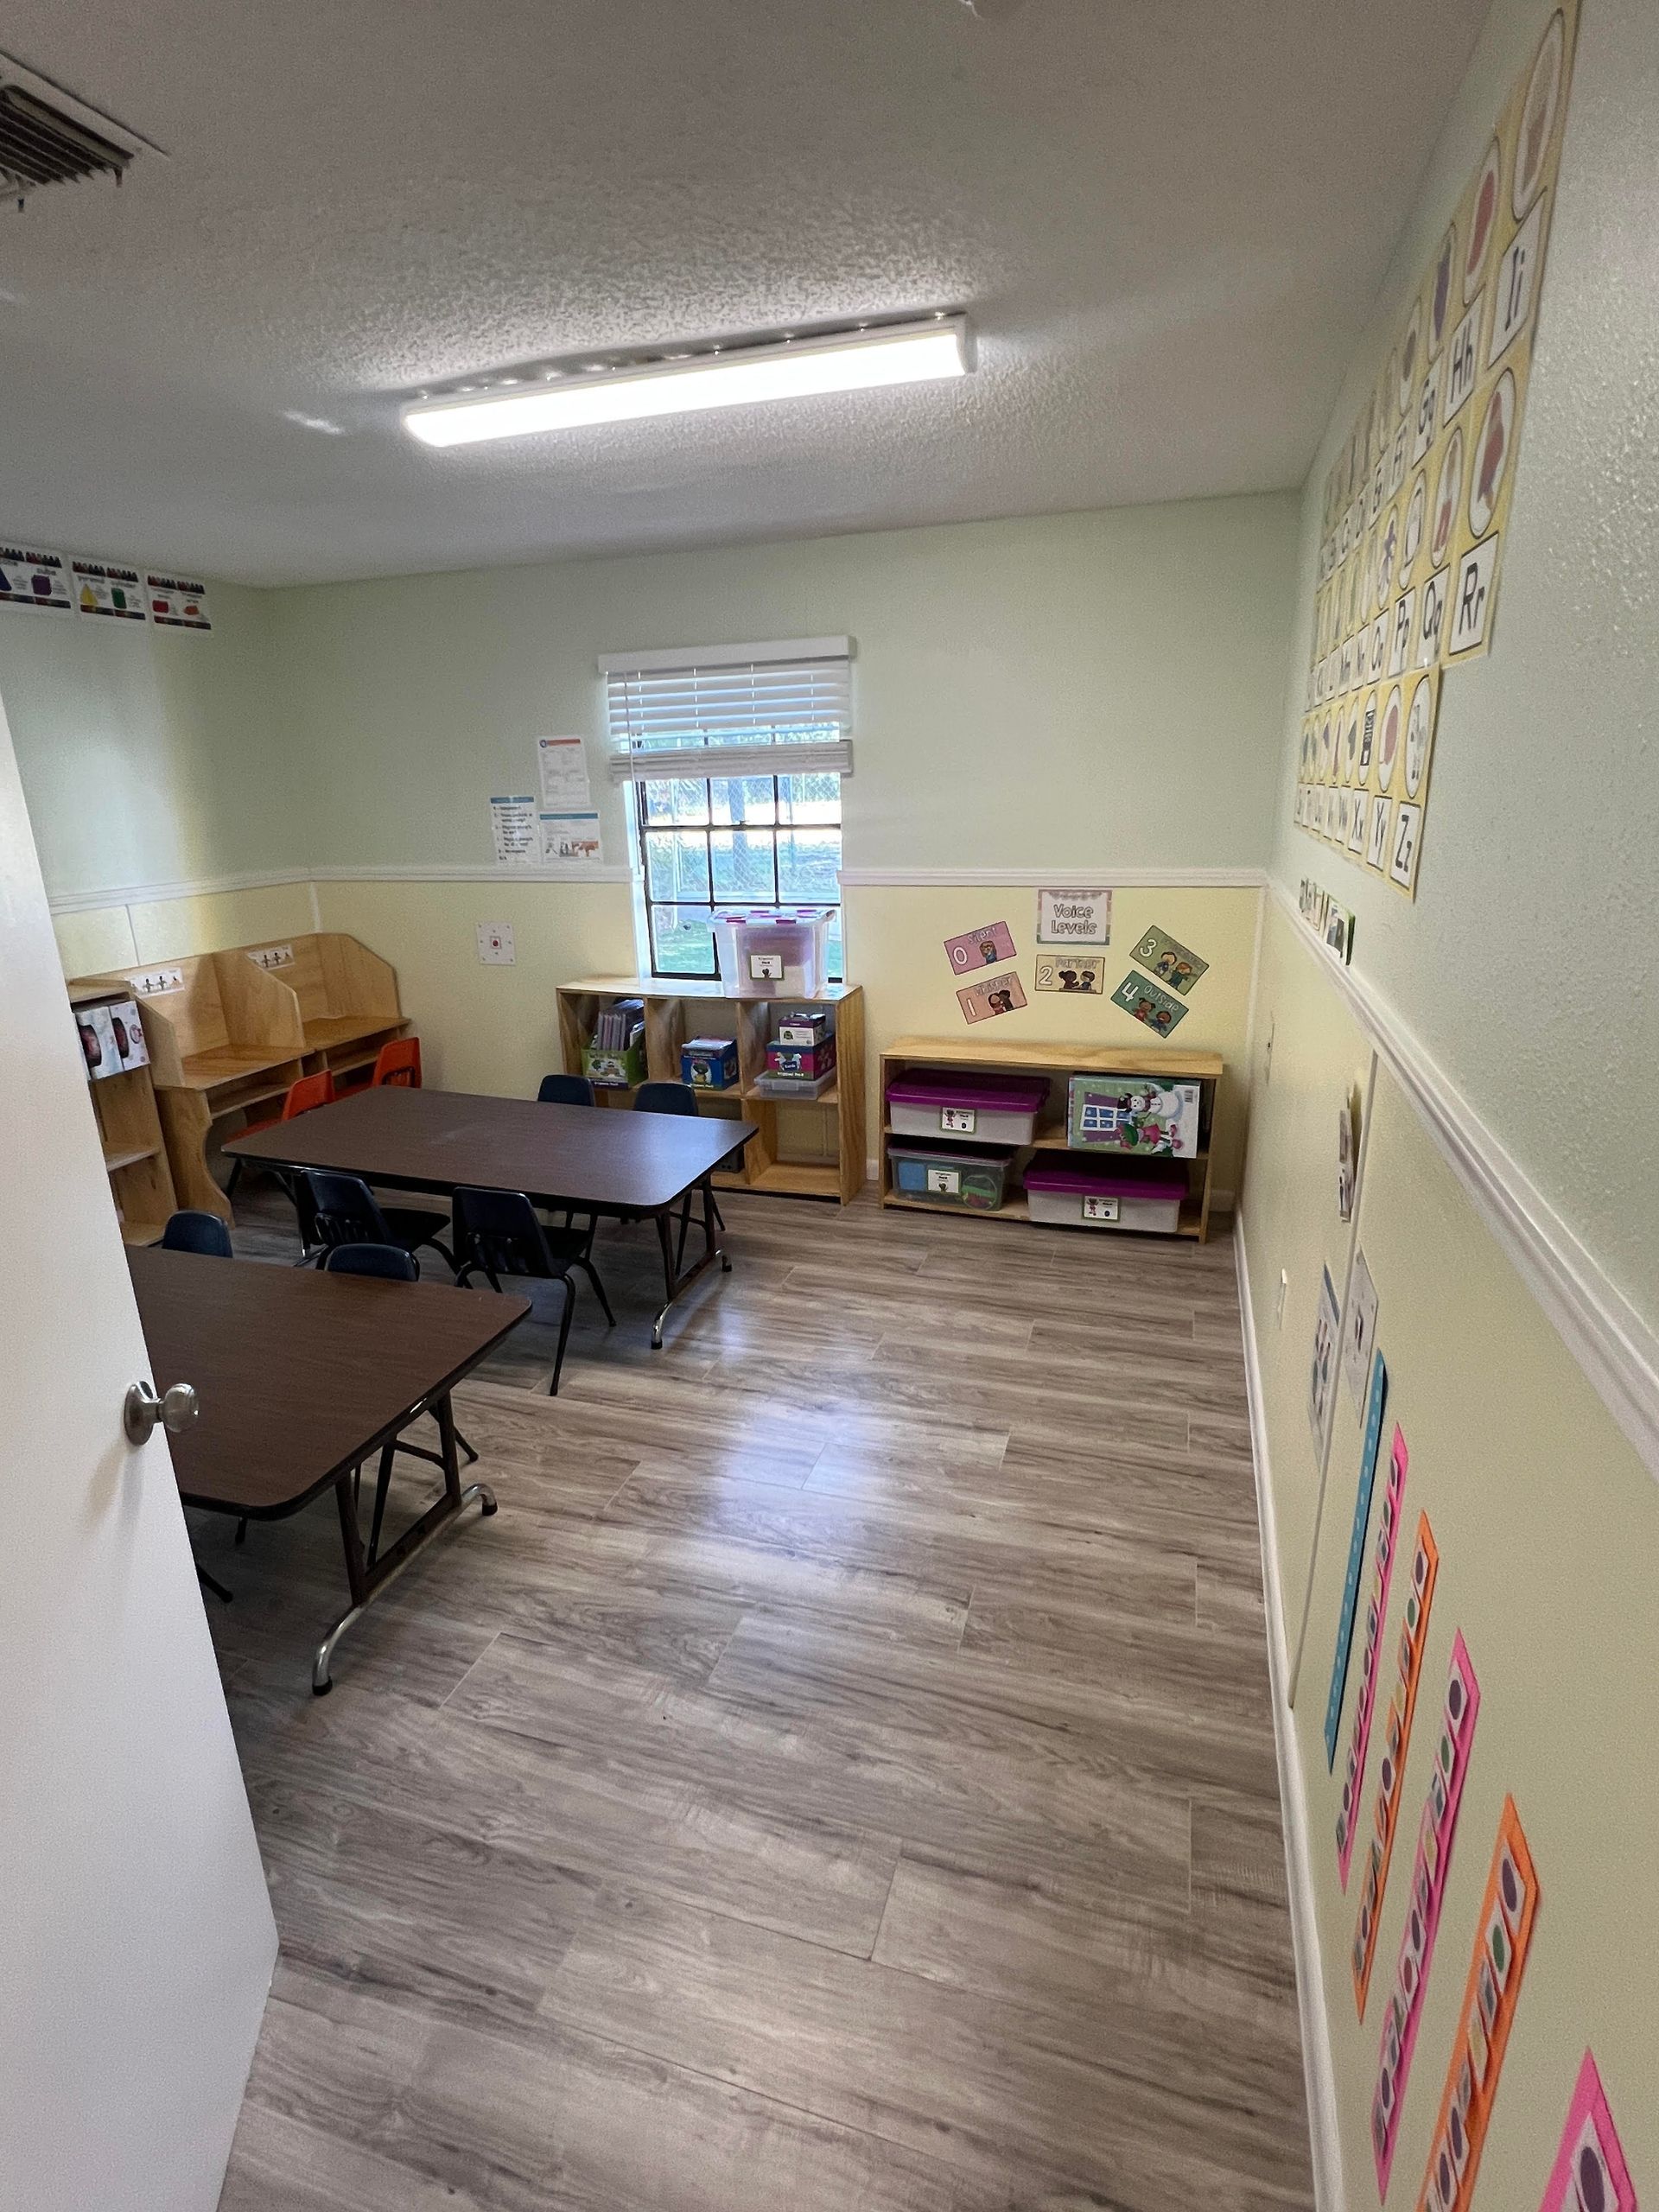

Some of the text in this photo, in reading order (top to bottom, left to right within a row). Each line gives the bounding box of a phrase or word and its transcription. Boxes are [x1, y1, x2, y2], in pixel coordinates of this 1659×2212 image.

[1505, 245, 1526, 332] Ii
[1450, 319, 1474, 404] Hh
[1459, 562, 1485, 635] Rr
[1423, 580, 1443, 659] Qq
[1395, 598, 1410, 670] Pp
[1352, 798, 1363, 841] Xx
[1376, 801, 1387, 864] Yy
[1395, 813, 1412, 873] Zz
[1053, 903, 1094, 918] Voice
[967, 927, 999, 945] Silent
[1051, 919, 1097, 935] Levels
[953, 945, 969, 966] 0
[1139, 938, 1158, 958] 3
[1039, 965, 1053, 986] 2
[1055, 957, 1100, 969] Partner
[974, 976, 1013, 997] Whisper
[1121, 981, 1140, 1002] 4
[1143, 984, 1179, 1013] Outside
